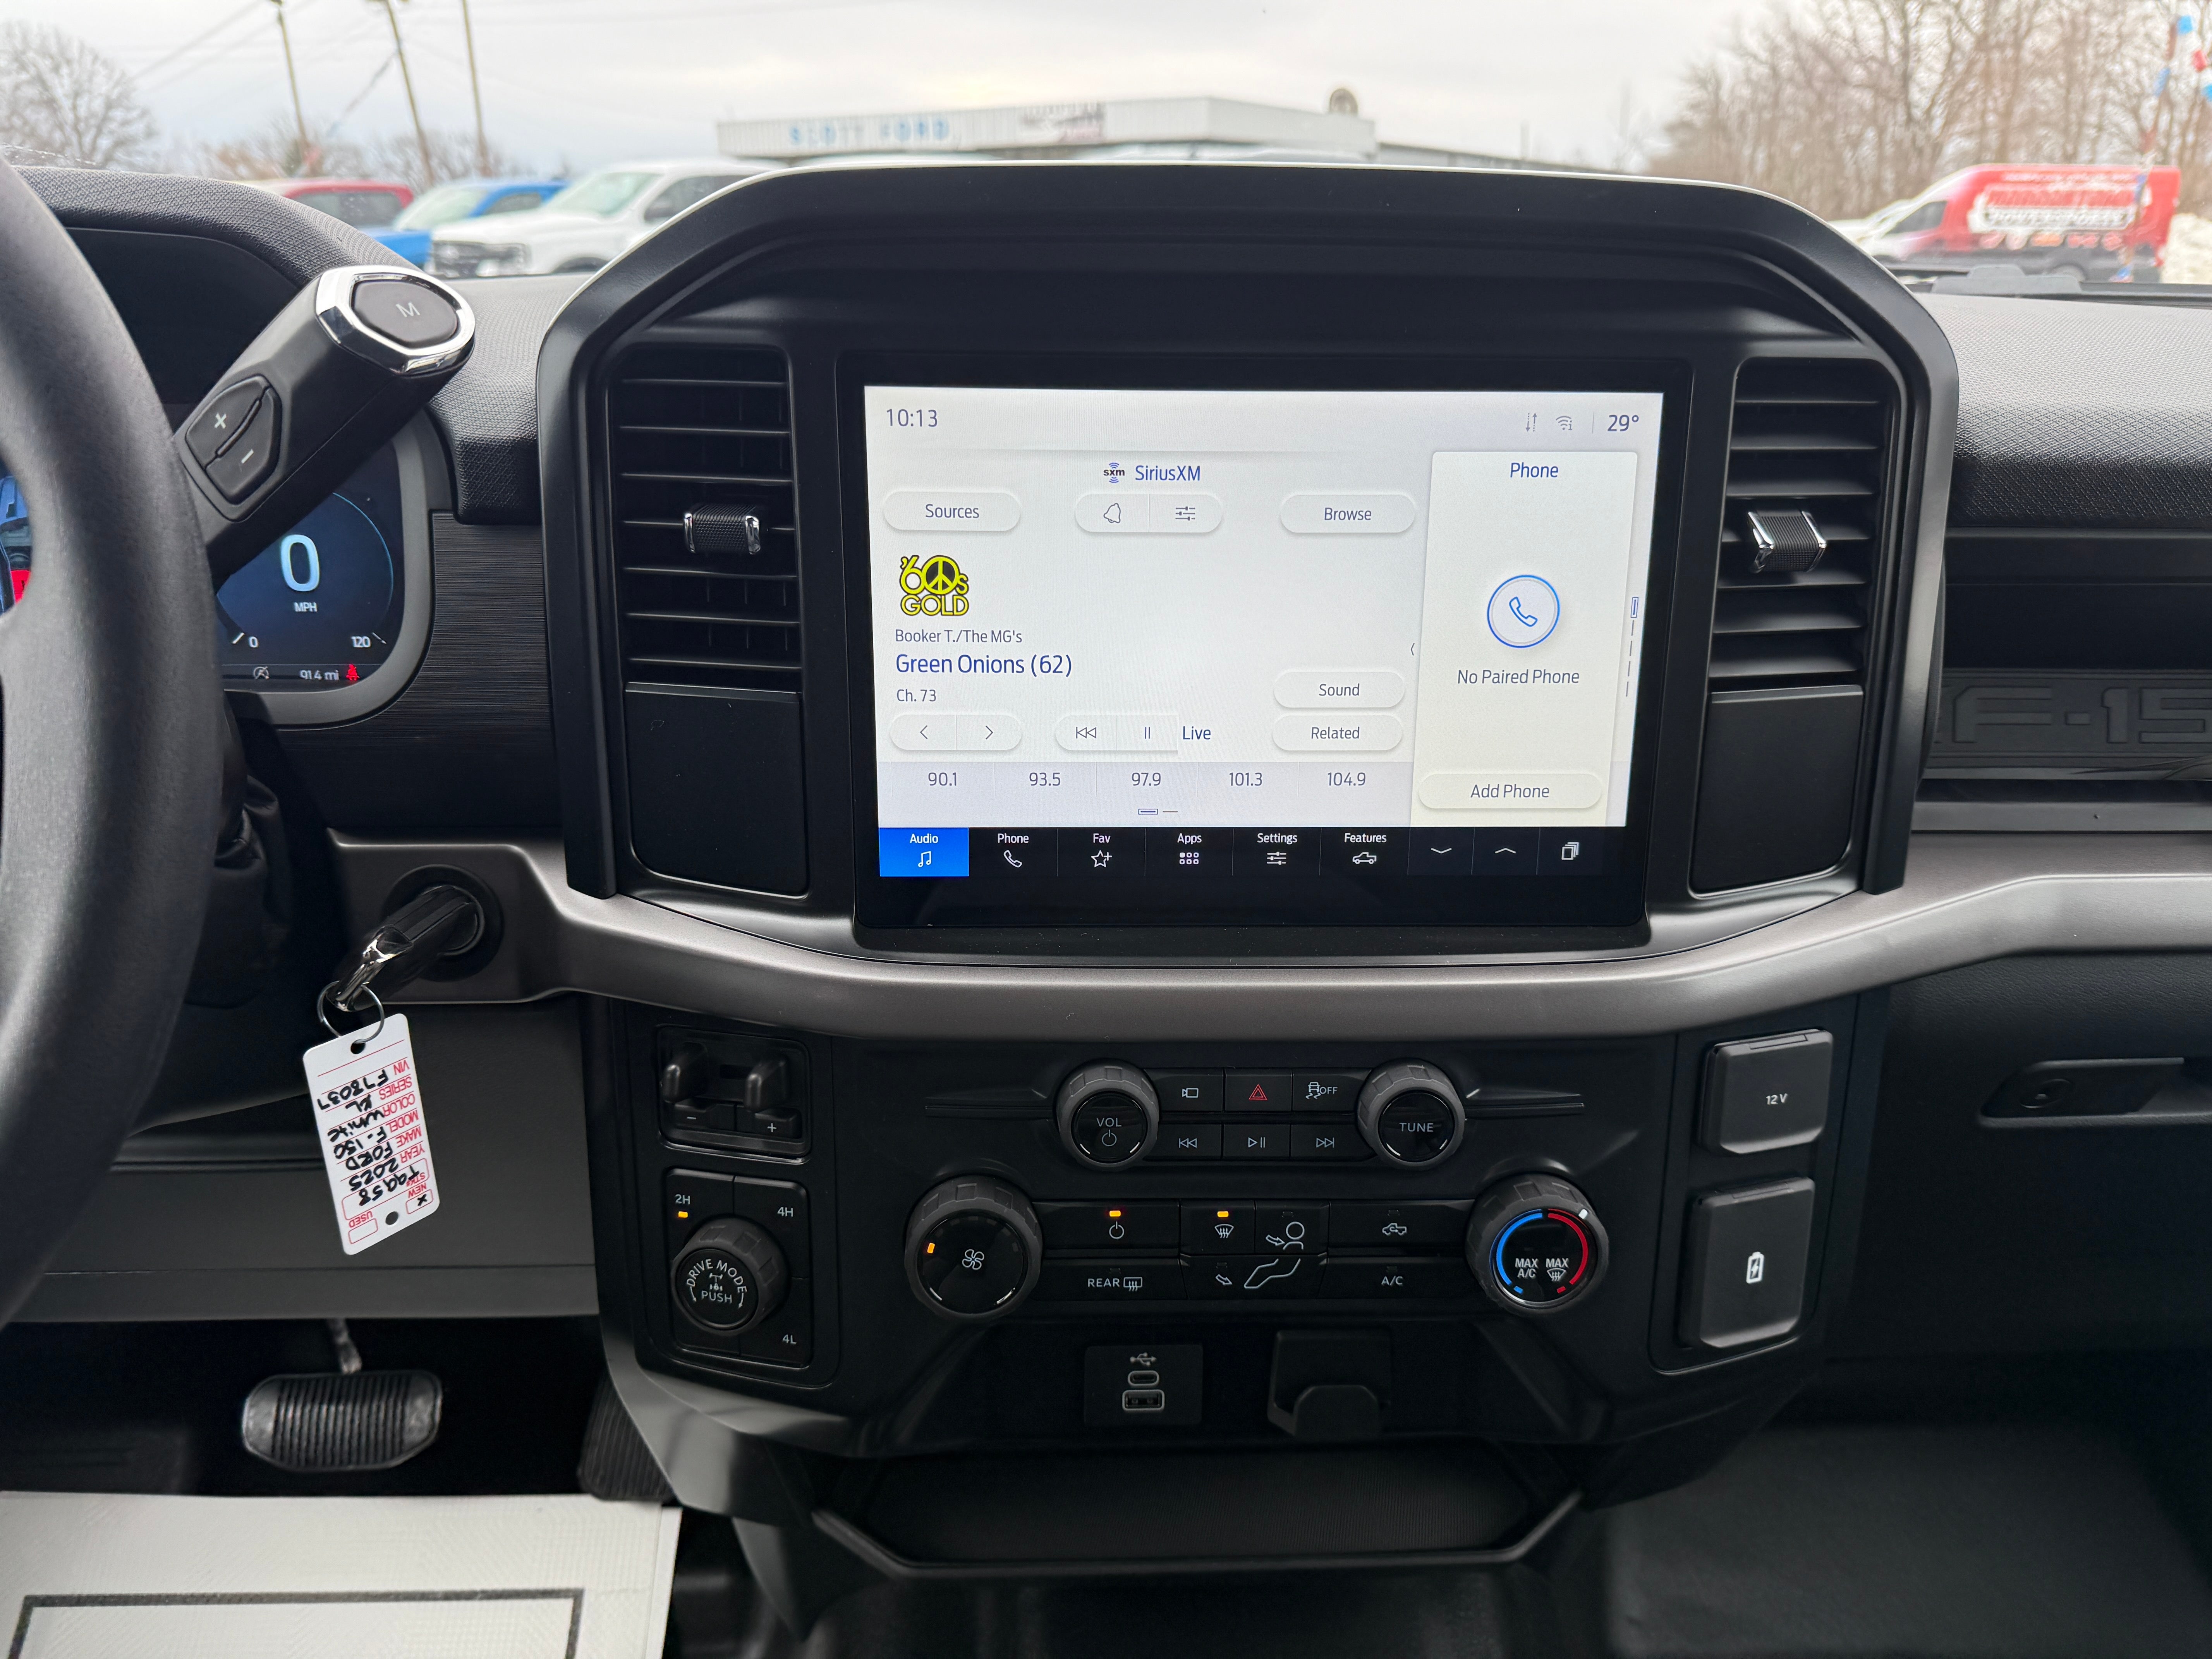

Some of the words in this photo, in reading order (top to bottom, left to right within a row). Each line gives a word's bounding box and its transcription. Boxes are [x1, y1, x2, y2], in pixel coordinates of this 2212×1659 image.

[879, 117, 950, 143] FORD
[396, 302, 420, 317] M
[886, 408, 938, 427] 10:13
[1103, 468, 1125, 477] sxm
[1135, 465, 1201, 482] SiriusXM
[1510, 462, 1559, 478] Phone
[925, 503, 979, 519] Sources
[1324, 507, 1372, 521] Browse
[281, 534, 320, 591] 0
[294, 602, 318, 612] MPH
[900, 594, 969, 616] GOLD
[248, 636, 258, 648] 0
[351, 636, 371, 648] 120
[895, 629, 941, 642] Booker
[944, 629, 988, 643] T./The
[991, 630, 1022, 643] MG's
[896, 654, 952, 673] Green
[958, 654, 1025, 673] Onions
[1031, 654, 1072, 677] (62)
[324, 670, 339, 680] mi
[1457, 670, 1478, 684] No
[1482, 669, 1528, 684] Paired
[1532, 669, 1580, 684] Phone
[896, 689, 917, 702] Ch.
[920, 689, 937, 702] 73
[1319, 683, 1360, 697] Sound
[1182, 726, 1211, 740] Live
[1311, 726, 1360, 740] Related
[928, 772, 958, 787] 90.1
[1029, 772, 1061, 787] 93.5
[1131, 772, 1162, 787] 97.9
[1229, 772, 1263, 787] 101.3
[1327, 772, 1366, 787] 104.9
[1470, 783, 1500, 798] Add
[1503, 784, 1549, 798] Phone
[909, 833, 939, 844] Audio
[997, 833, 1029, 844] Phone
[1093, 833, 1111, 844] Fav
[1176, 833, 1202, 846] Apps
[1257, 832, 1298, 845] Settings
[1344, 832, 1387, 843] Features
[393, 1060, 410, 1075] VIN
[378, 1076, 412, 1100] SERIES
[1319, 1086, 1338, 1095] OFF
[382, 1093, 416, 1117] COLOR
[386, 1109, 419, 1133] MODEL
[1096, 1117, 1122, 1127] VOL
[1399, 1122, 1434, 1133] TUNE
[395, 1126, 422, 1148] MAKE
[345, 1141, 393, 1171] FORD
[400, 1144, 425, 1163] YEAR
[349, 1157, 399, 1192] 2025
[408, 1182, 427, 1199] NEW
[675, 1194, 691, 1205] 2H
[349, 1210, 373, 1228] USED
[777, 1207, 794, 1218] 4H
[1515, 1258, 1538, 1269] MAX
[1545, 1258, 1569, 1268] MAX
[687, 1259, 713, 1287] DRIVE
[716, 1260, 747, 1293] MODE
[1381, 1275, 1403, 1286] A/C
[1517, 1268, 1537, 1279] A/C
[1087, 1278, 1120, 1288] REAR
[701, 1290, 732, 1304] PUSH
[782, 1334, 797, 1345] 4L
